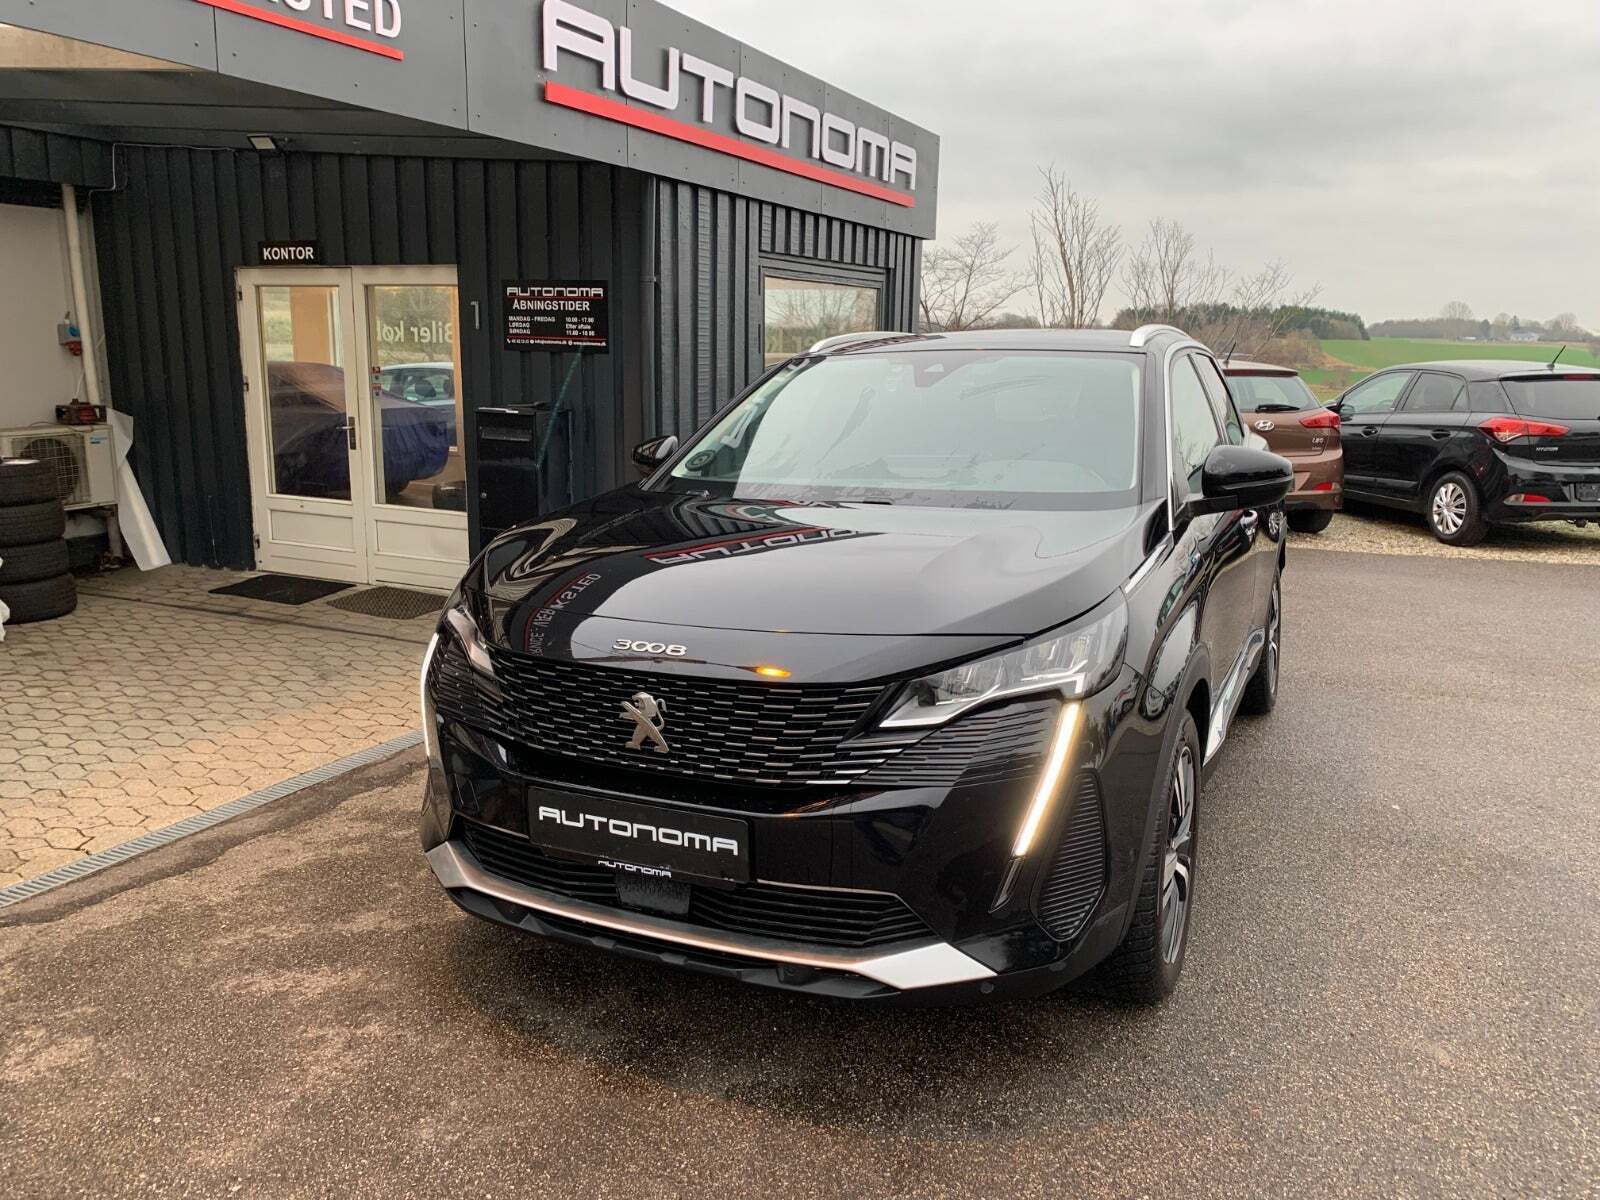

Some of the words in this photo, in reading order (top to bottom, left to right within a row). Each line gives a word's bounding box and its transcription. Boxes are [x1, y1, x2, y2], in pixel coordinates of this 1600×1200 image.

[543, 0, 917, 190] AUTONOMA
[263, 247, 314, 260] KONTOR
[507, 287, 603, 297] AUTONOMA
[513, 298, 590, 311] ÅBNINGSTIDER
[612, 639, 688, 656] 3008
[538, 806, 738, 856] AUTONOMA
[598, 860, 672, 878] AUTONOMA
